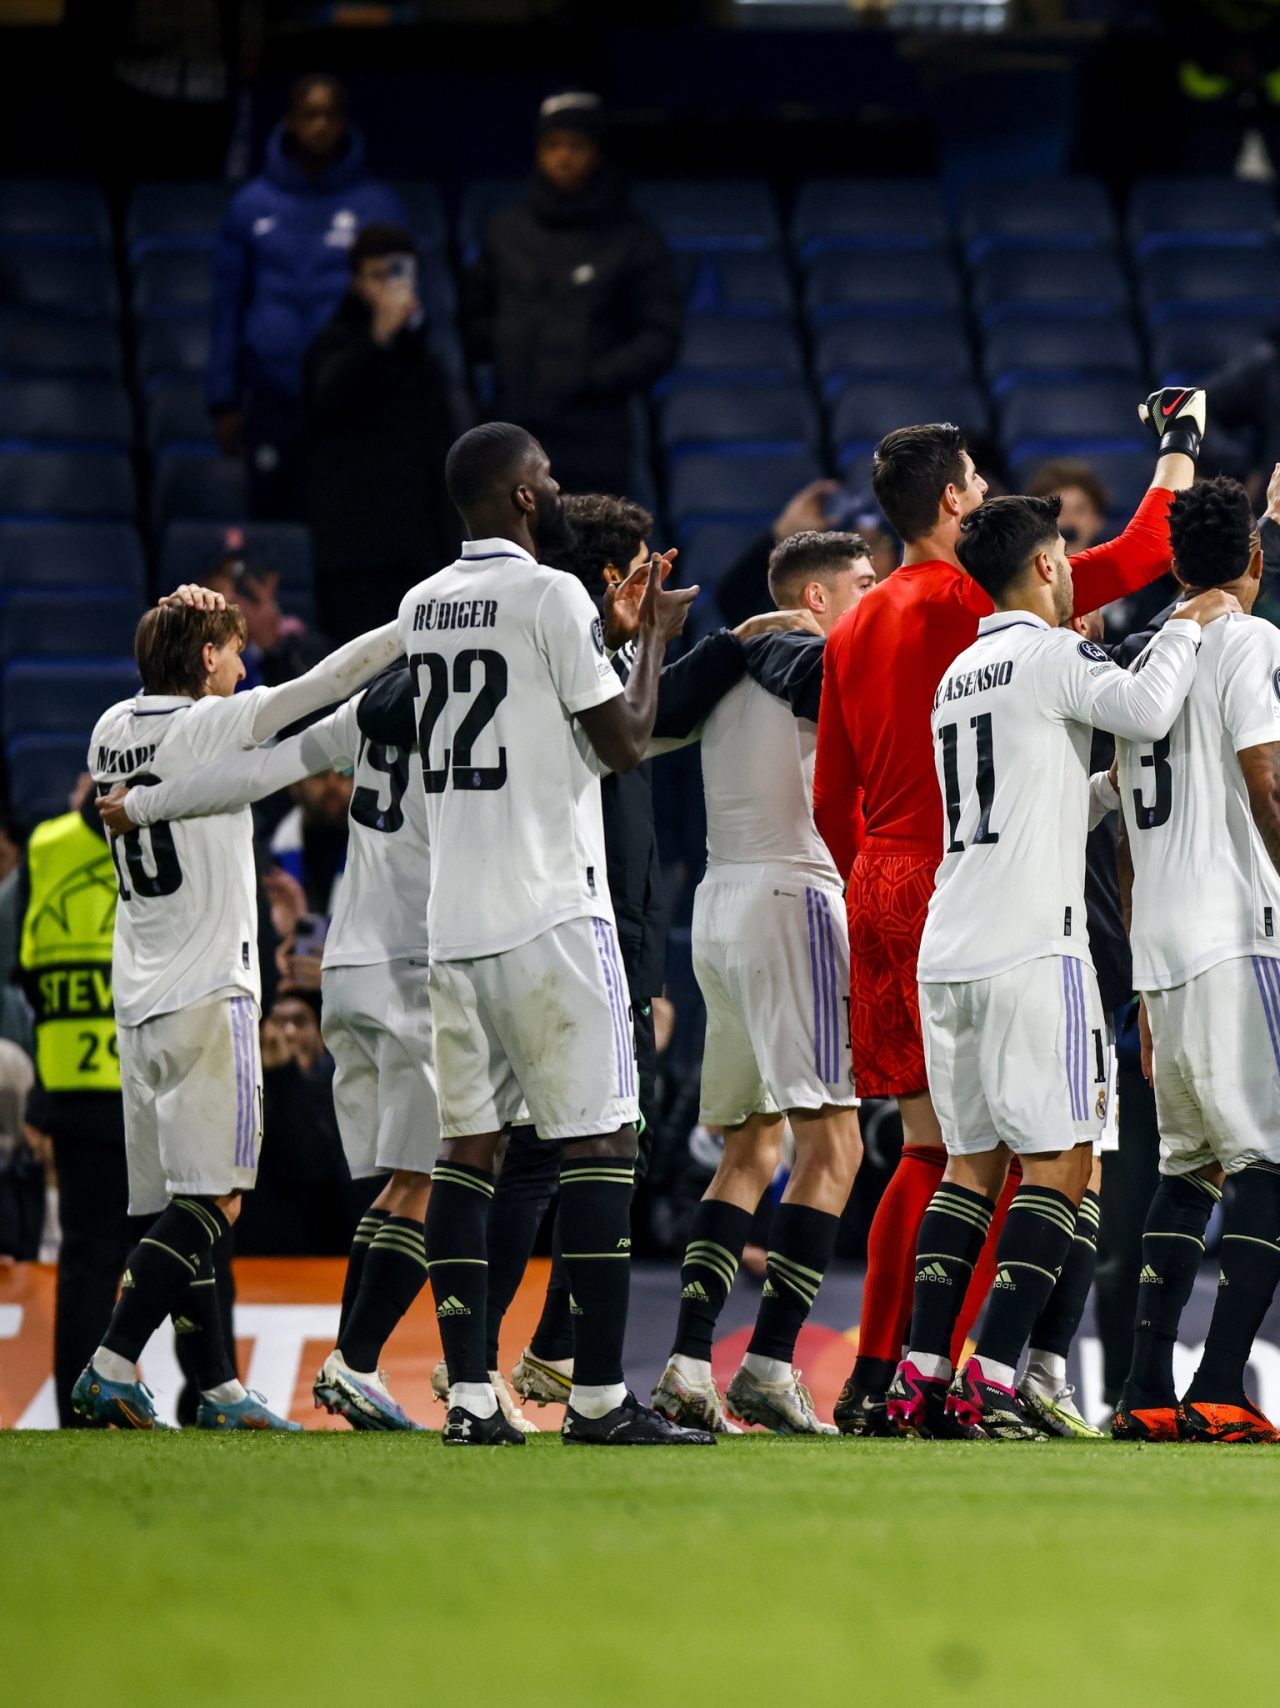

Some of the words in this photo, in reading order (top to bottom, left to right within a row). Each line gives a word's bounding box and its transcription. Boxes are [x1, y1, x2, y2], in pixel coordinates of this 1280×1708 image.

[413, 599, 498, 631] RÜDIGER
[409, 648, 508, 793] 22
[943, 660, 1014, 702] ASENSIO
[938, 712, 999, 854] 11
[1133, 731, 1173, 830] 3
